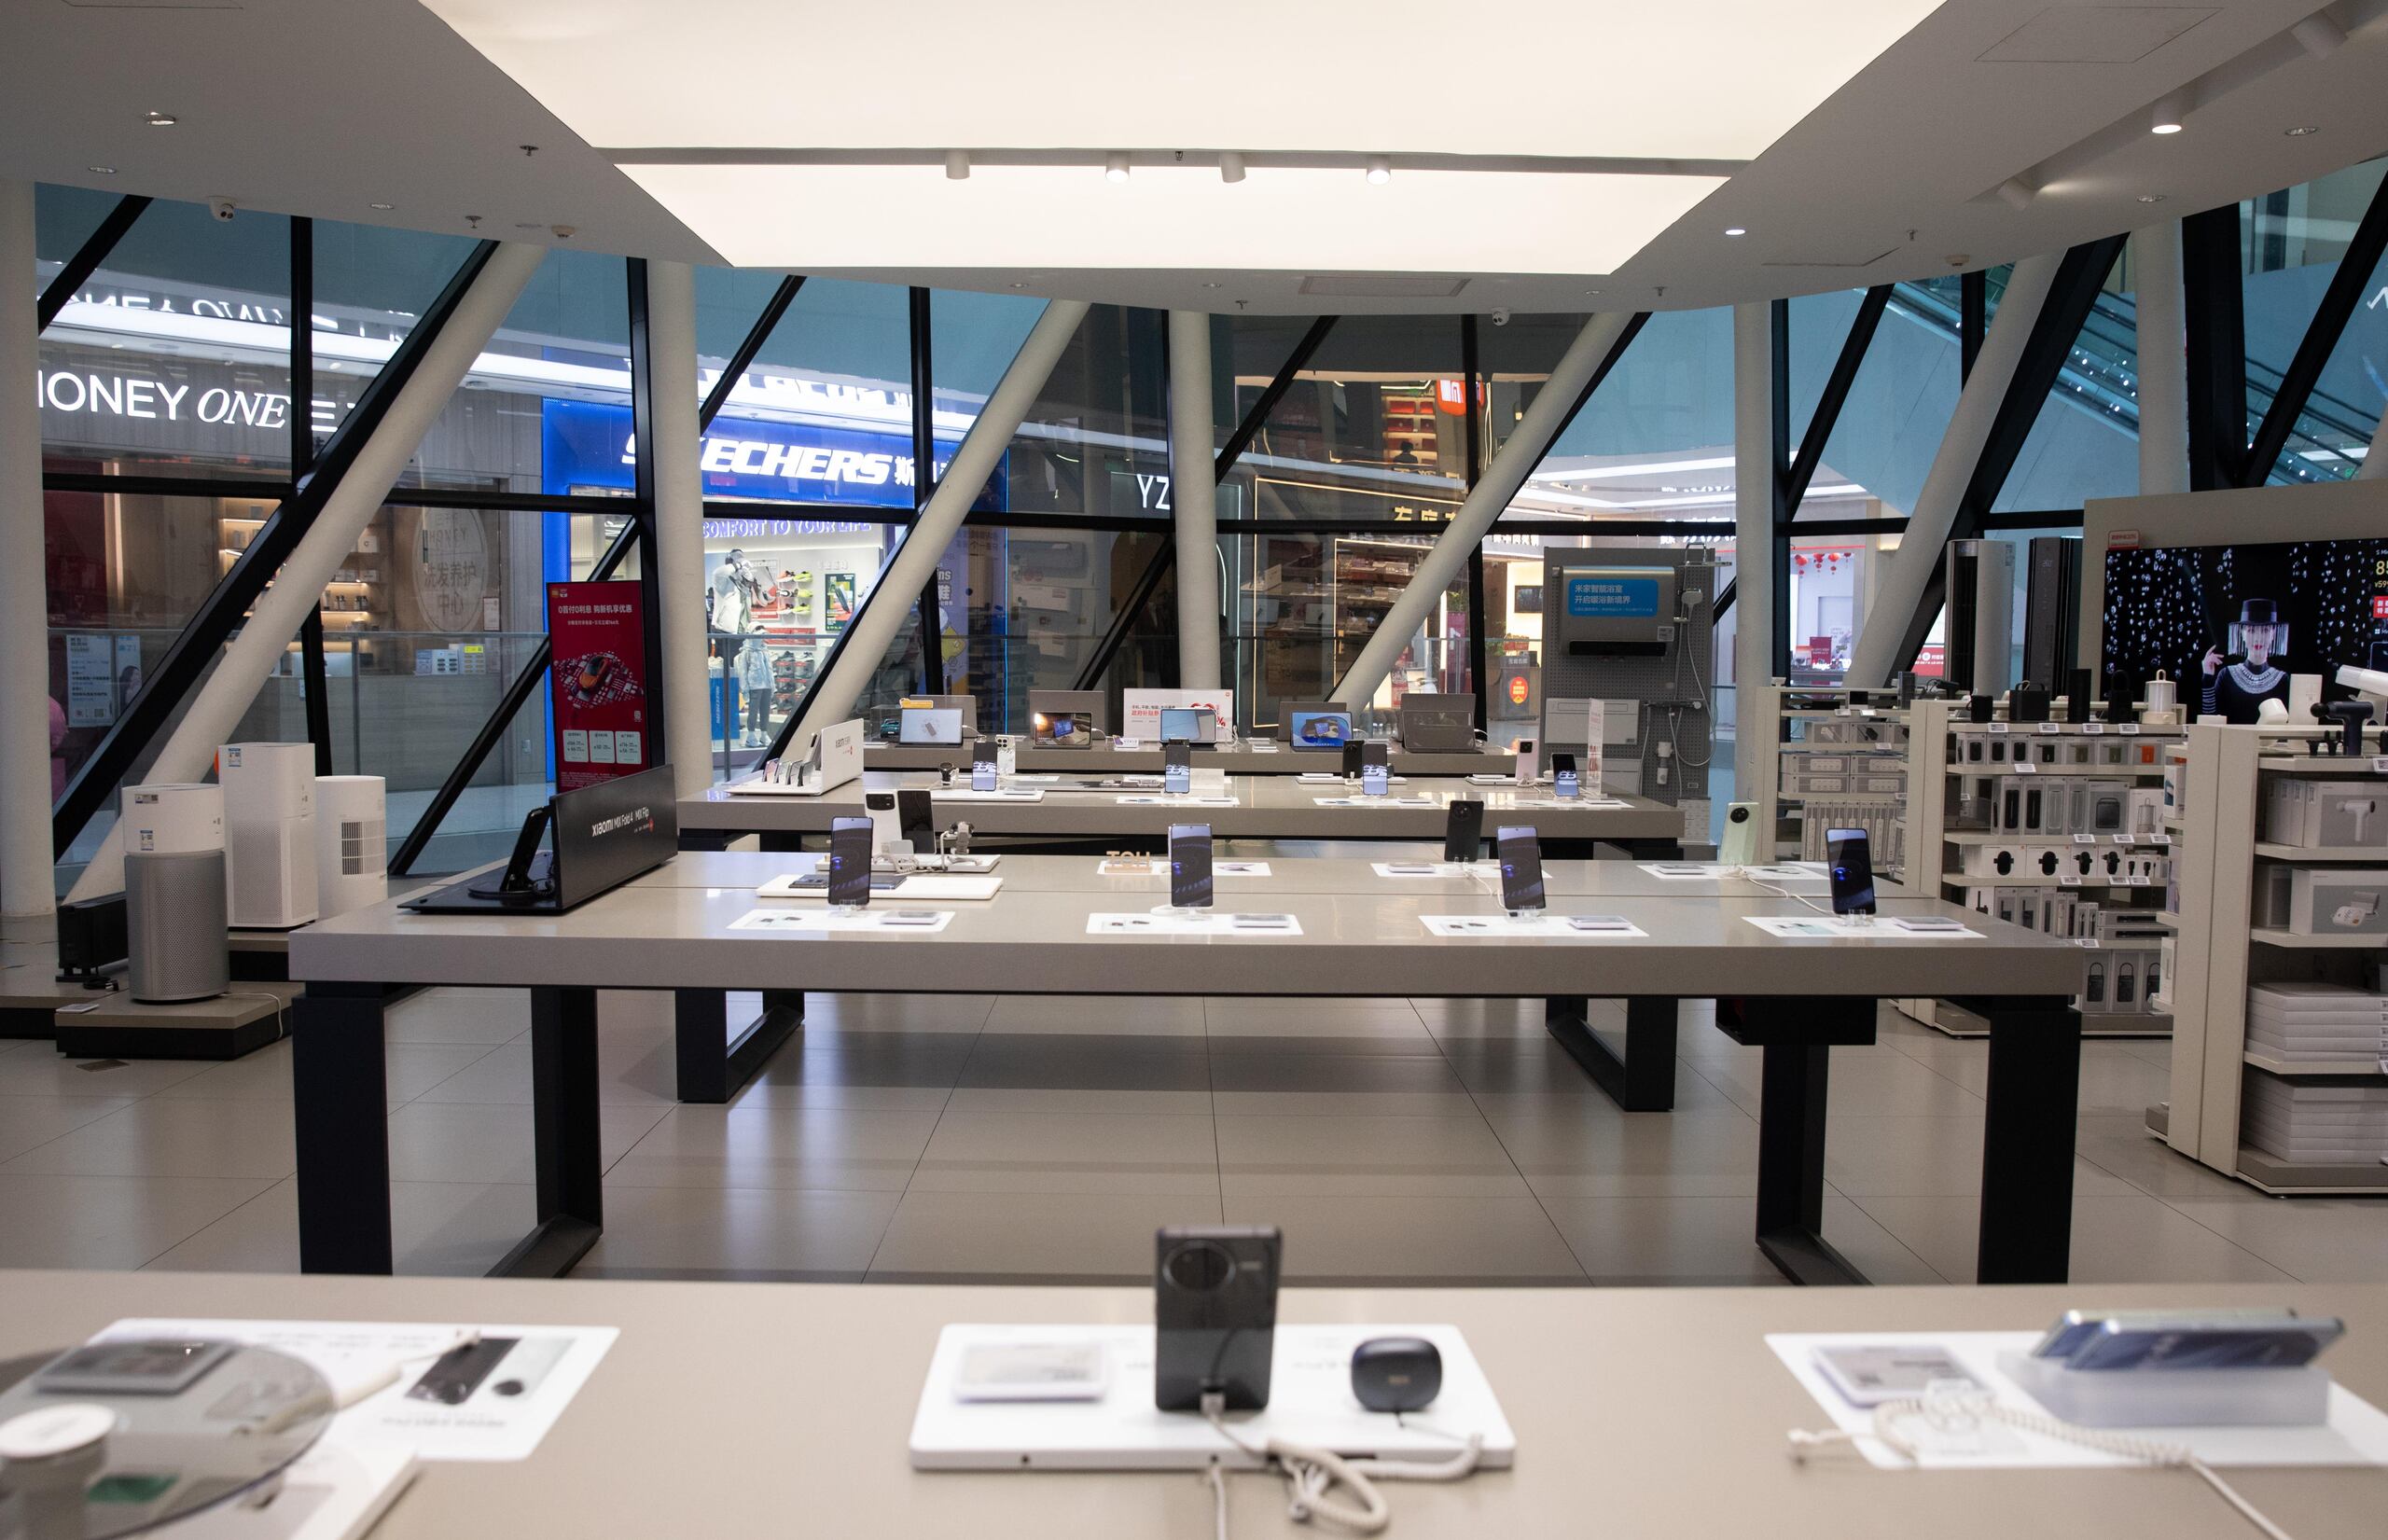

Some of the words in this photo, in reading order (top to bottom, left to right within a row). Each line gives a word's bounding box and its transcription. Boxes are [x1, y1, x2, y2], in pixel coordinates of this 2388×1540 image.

[197, 388, 291, 428] ONE
[621, 433, 892, 484] ECHERS
[438, 590, 464, 617] 中心
